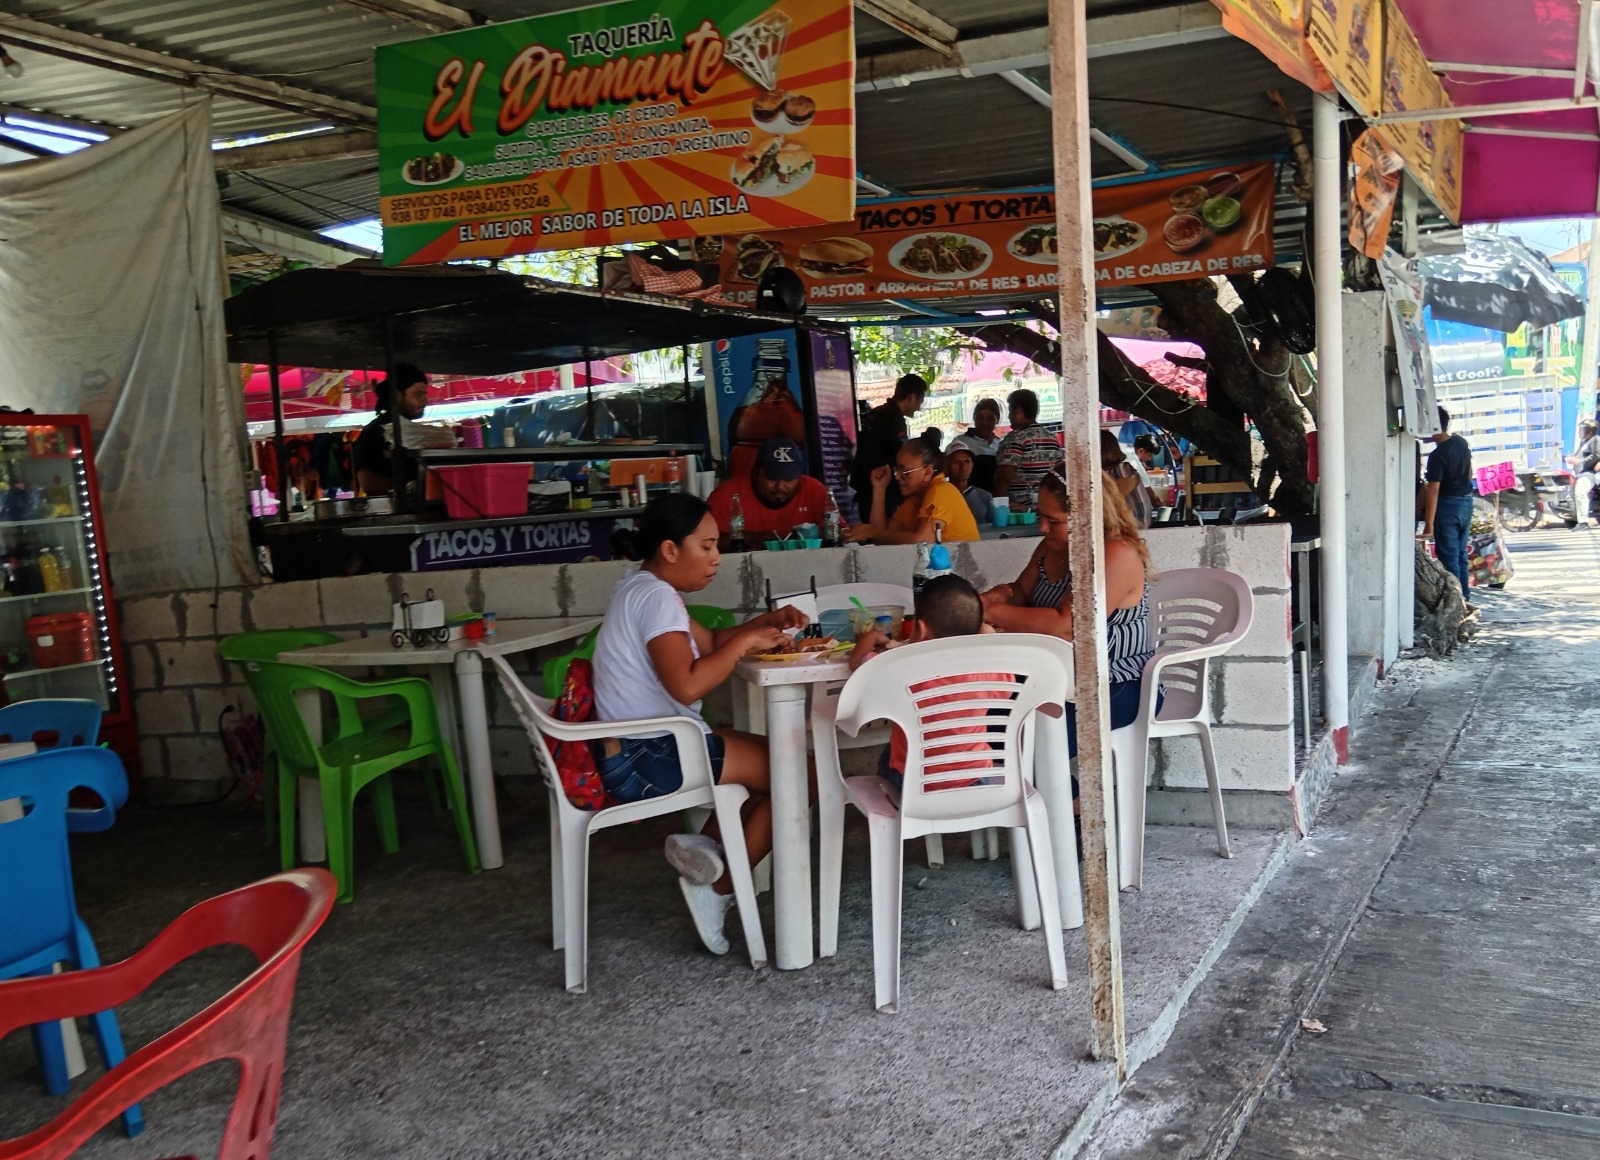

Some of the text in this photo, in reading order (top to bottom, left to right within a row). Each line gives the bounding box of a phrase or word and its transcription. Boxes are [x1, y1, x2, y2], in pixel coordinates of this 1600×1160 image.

[569, 14, 674, 57] TAQUERÍA
[424, 18, 726, 138] El Diamante
[526, 116, 567, 137] CARNE
[569, 112, 585, 131] DE
[615, 109, 631, 124] DE
[633, 103, 678, 122] CERDO
[464, 129, 752, 181] SALCHICHA PARA ASAR Y CHORIZO ARGENTINO
[549, 128, 616, 152] CHISTORRA
[619, 127, 631, 144] Y
[390, 182, 540, 211] SERVICIOS PARA EVENTOS
[390, 210, 412, 223] 938
[414, 208, 430, 221] 137
[433, 205, 457, 220] 1748
[466, 199, 511, 216] 938405
[513, 195, 551, 210] 95248
[858, 194, 1056, 231] TACOS Y TORTA
[458, 194, 750, 243] EL MEJOR SABOR DE TODA LA ISLA
[1114, 265, 1136, 281] DE
[1138, 259, 1203, 278] CABEZA
[1206, 257, 1229, 271] DE
[1231, 254, 1264, 269] RES
[810, 283, 867, 299] PASTOR
[968, 279, 990, 292] DE
[992, 275, 1020, 290] RES
[718, 356, 736, 394] pepsi
[1455, 367, 1490, 380] Gool
[1482, 475, 1514, 493] KILO
[425, 528, 497, 560] TACOS
[500, 526, 516, 552] Y
[519, 520, 591, 550] TORTAS
